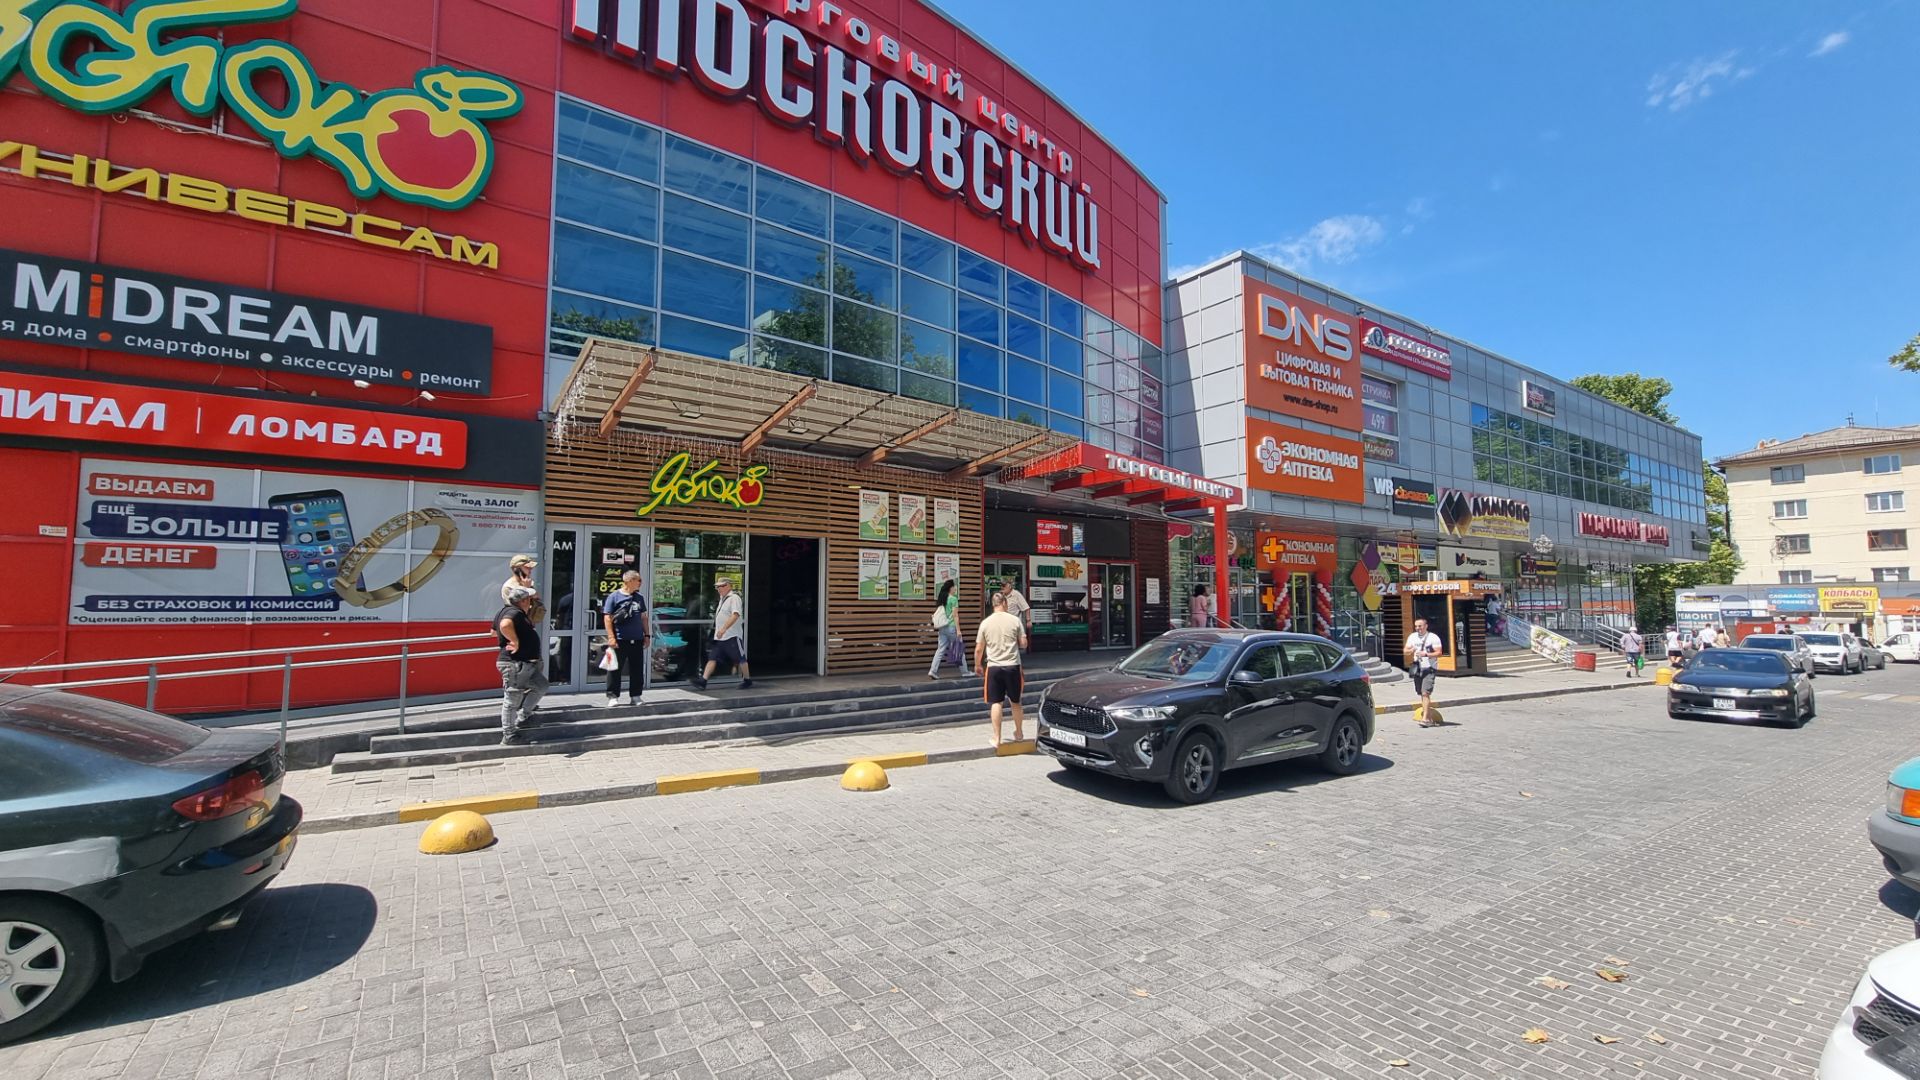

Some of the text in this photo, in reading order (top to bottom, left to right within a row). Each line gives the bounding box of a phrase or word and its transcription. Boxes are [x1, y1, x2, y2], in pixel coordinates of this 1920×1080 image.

[977, 95, 1073, 175] центр
[1258, 293, 1353, 361] DNS
[24, 322, 87, 341] дома
[124, 333, 250, 364] смартфоны
[281, 353, 393, 379] аксессуары
[419, 372, 482, 391] ремонт
[1276, 350, 1341, 380] ЦИФРОВАЯ И
[1260, 363, 1354, 399] БЫТОВАЯ ТЕХНИКА
[1371, 413, 1386, 430] 499
[228, 414, 444, 458] ЛОМБАРД
[1281, 441, 1359, 469] ЭКОНОМНАЯ
[1105, 453, 1234, 499] ТОРГОВЫЙ ЦЕНТР
[1282, 461, 1334, 482] АПТЕКА
[95, 477, 207, 496] ВЫДАЕМ
[1373, 476, 1394, 496] WB
[97, 503, 136, 516] ЕЩЁ
[461, 498, 520, 508] под ЗАЛОГ
[126, 516, 280, 540] БОЛЬШЕ
[100, 546, 199, 565] ДЕНЕГ
[1281, 553, 1317, 565] АПТЕКА
[1377, 582, 1398, 595] 24
[1402, 583, 1424, 592] КОФЕ
[1823, 589, 1873, 598] КОЛБАСЫ
[97, 598, 335, 609] БЕЗ СТРАХОВОК И КОМИССИЙ
[189, 615, 263, 625] финансовые
[265, 615, 338, 623] возможности
